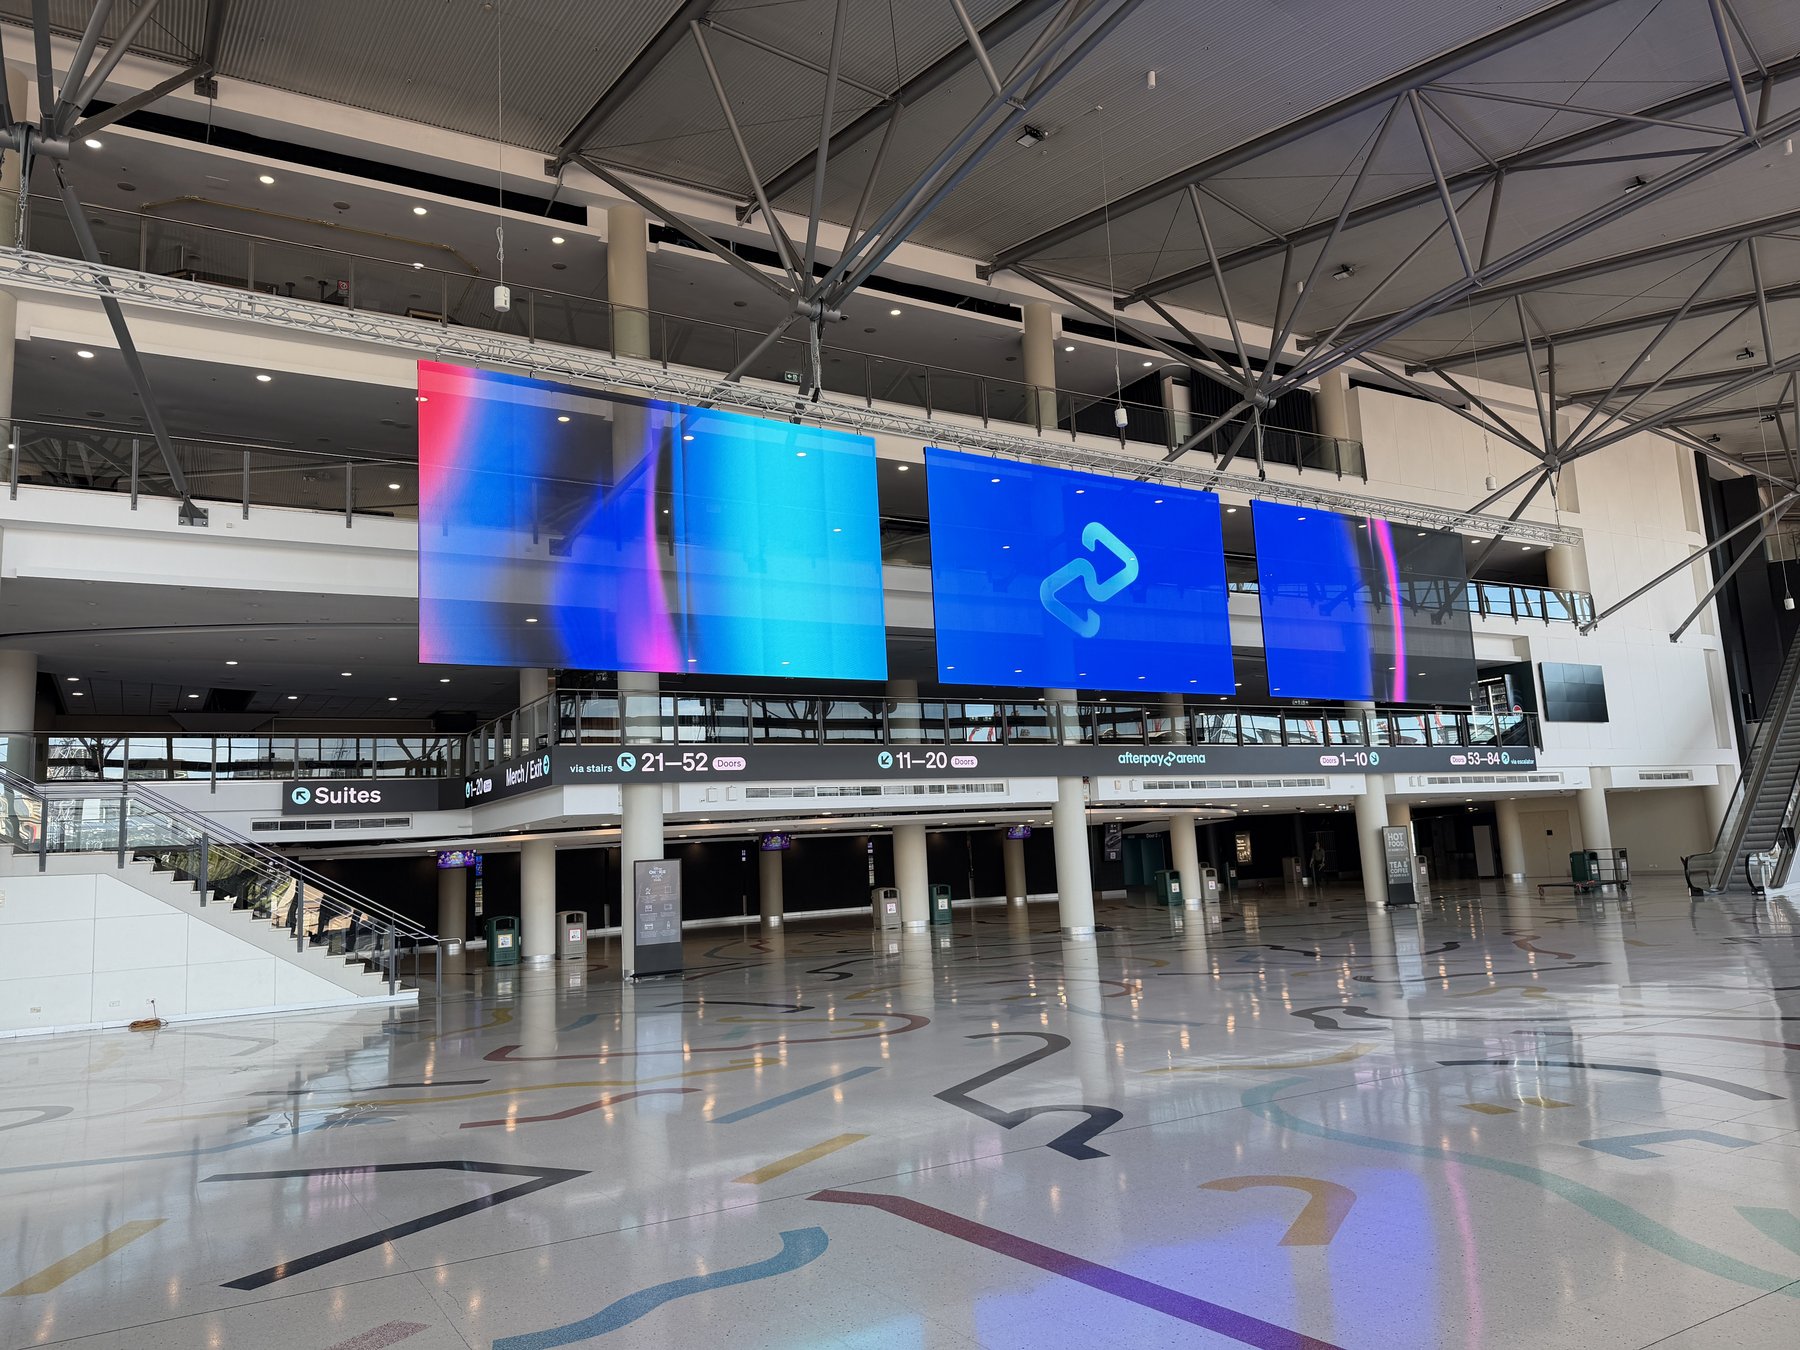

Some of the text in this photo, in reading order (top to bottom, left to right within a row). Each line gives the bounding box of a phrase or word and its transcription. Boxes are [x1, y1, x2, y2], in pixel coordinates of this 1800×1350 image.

[954, 758, 975, 766] Doors
[1118, 751, 1206, 767] afterpay arena
[505, 763, 525, 787] Merch
[530, 758, 543, 780] Exit
[570, 764, 585, 773] via
[586, 764, 613, 773] stairs
[717, 760, 742, 768] Doors
[314, 786, 382, 805] Suites
[1387, 833, 1404, 841] HOT
